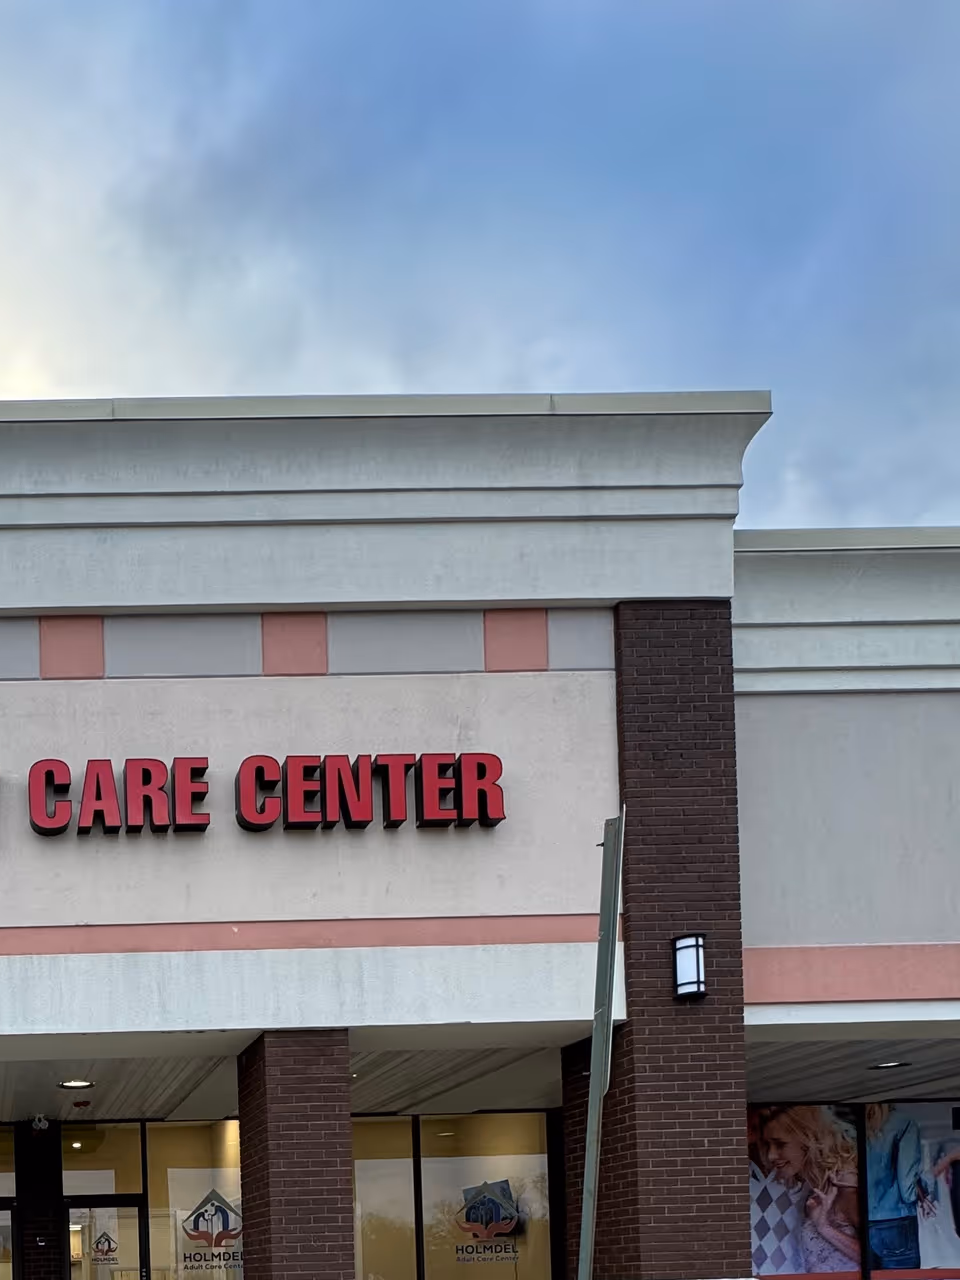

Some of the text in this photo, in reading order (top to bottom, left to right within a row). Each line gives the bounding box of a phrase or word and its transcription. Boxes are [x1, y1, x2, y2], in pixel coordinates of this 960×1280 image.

[28, 757, 211, 837] CARE
[235, 752, 507, 832] CENTER
[455, 1244, 519, 1255] HOLMDEL
